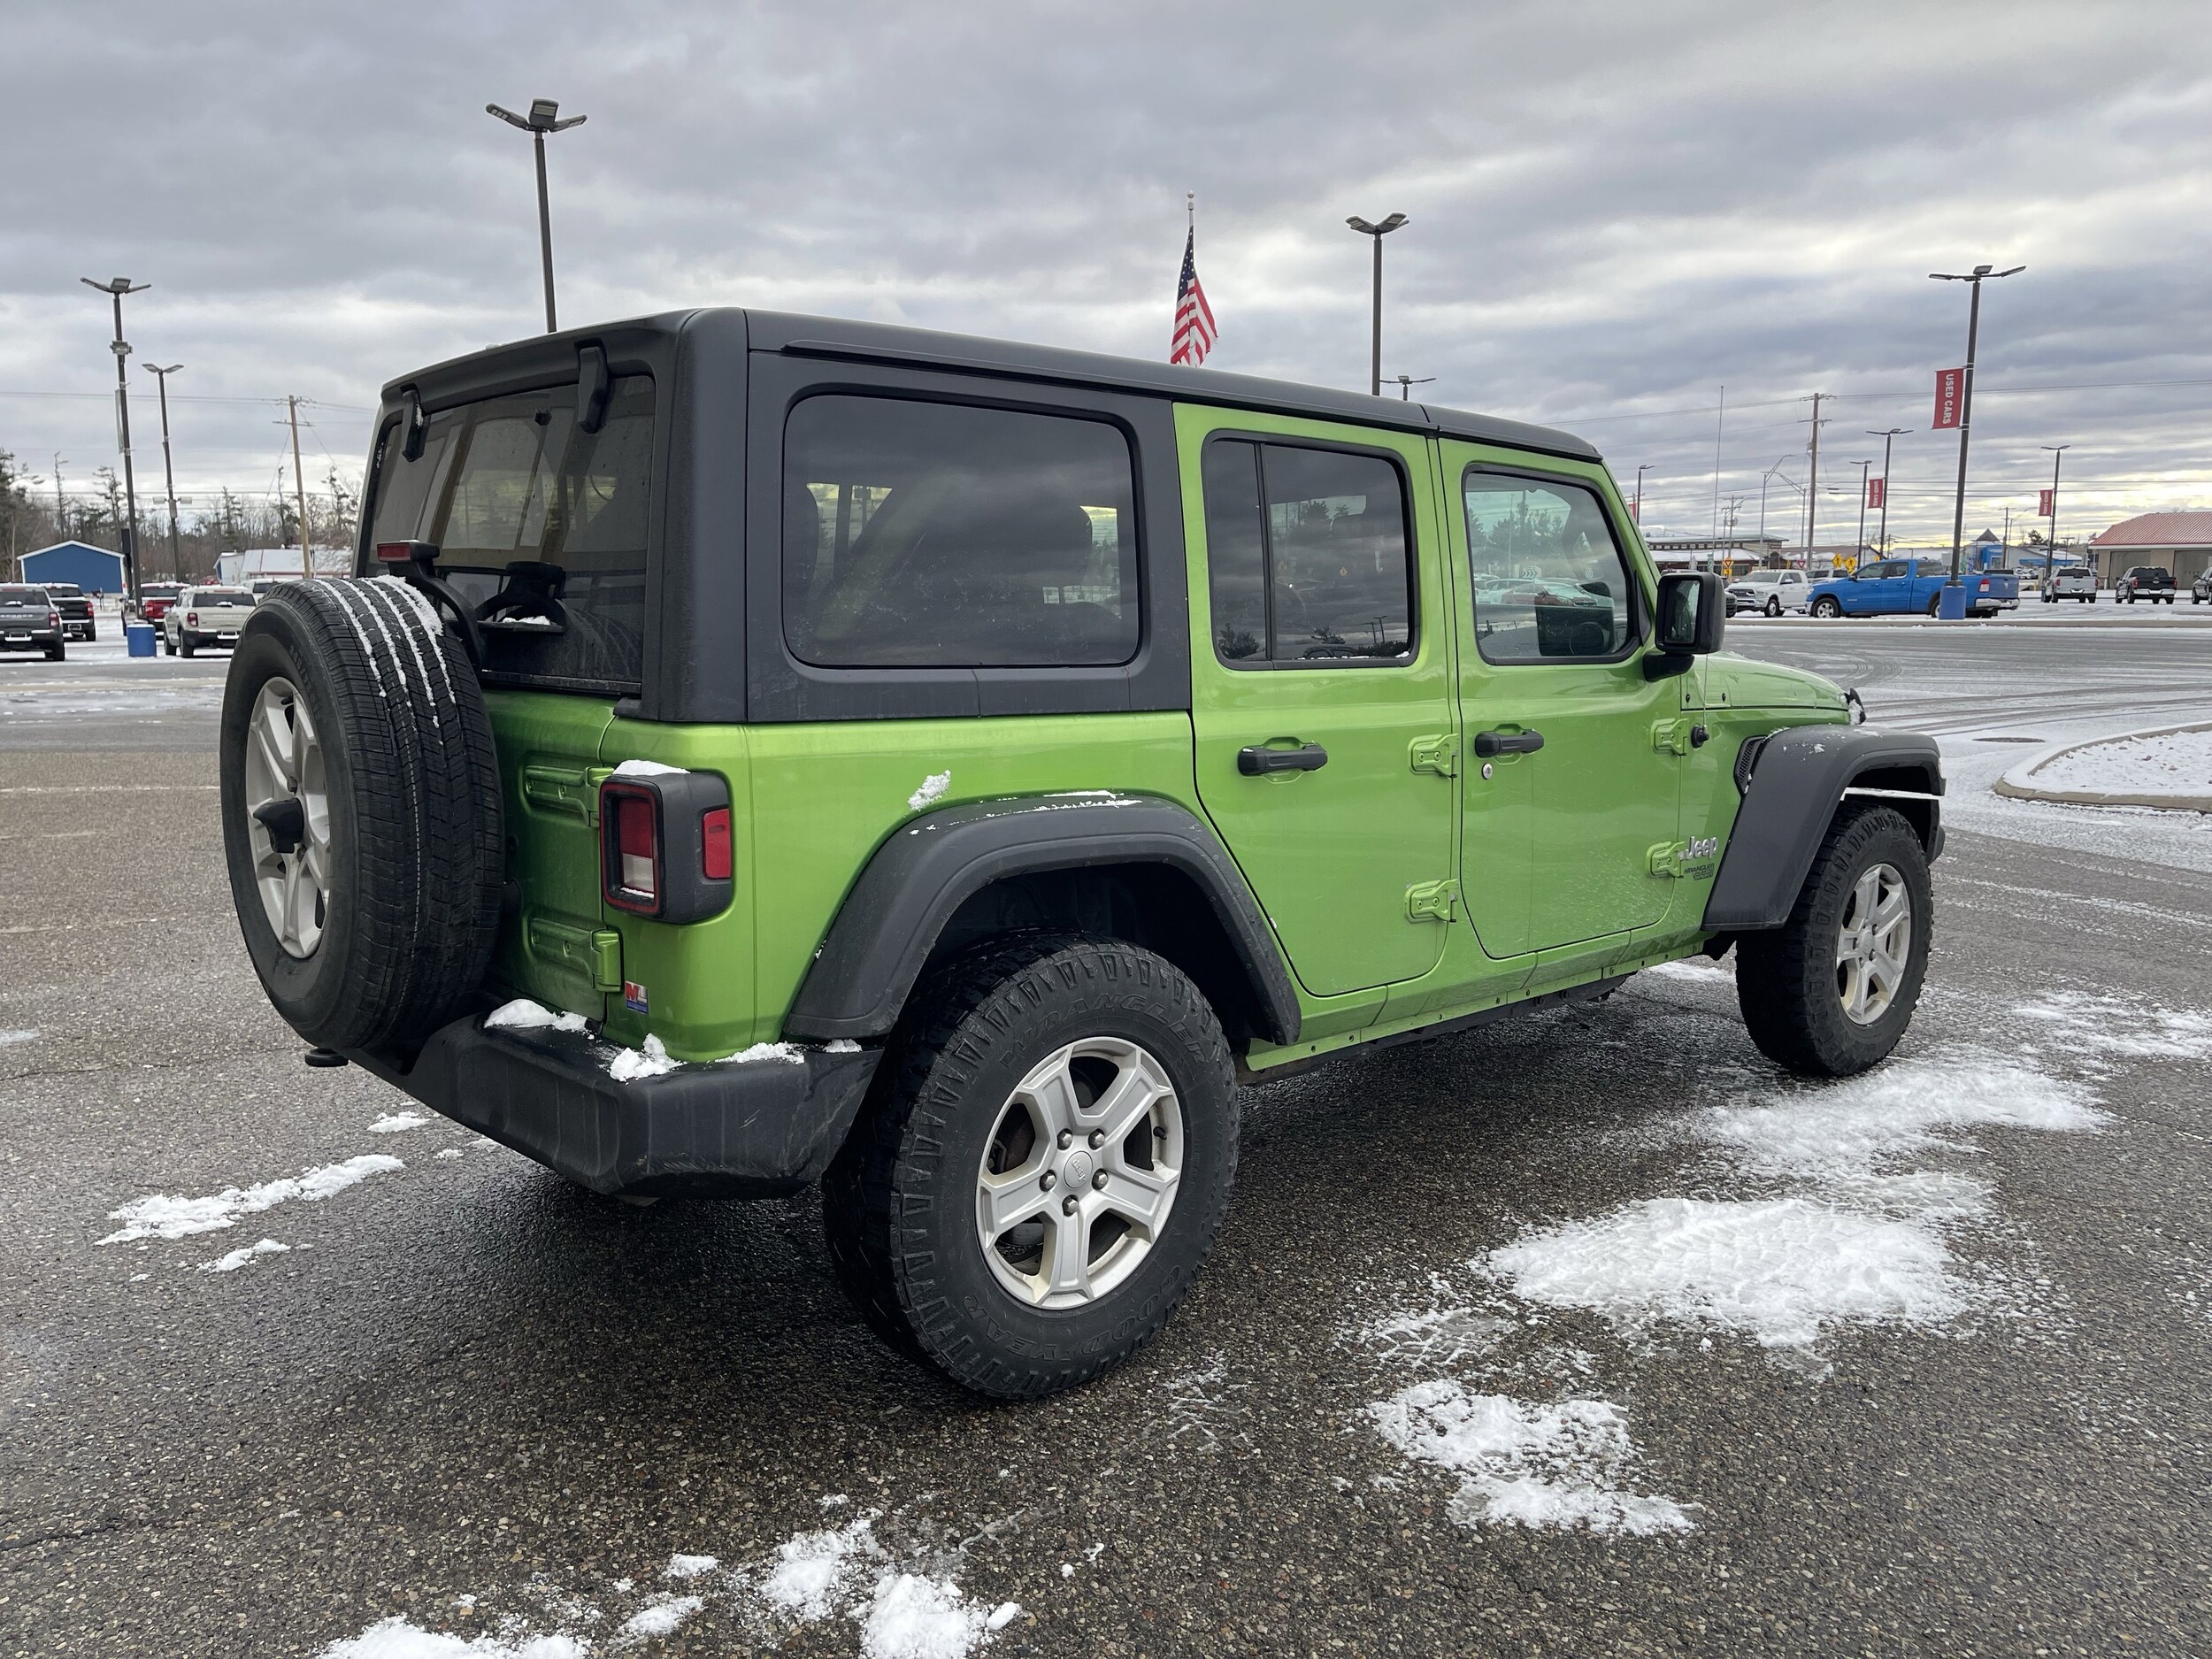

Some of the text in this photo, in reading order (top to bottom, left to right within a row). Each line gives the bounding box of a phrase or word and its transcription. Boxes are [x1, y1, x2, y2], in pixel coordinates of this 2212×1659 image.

[1942, 373, 1954, 425] USED CARS
[1685, 835, 1717, 859] Jeep
[999, 993, 1207, 1066] WRANGLER
[1071, 1158, 1087, 1182] Jeep
